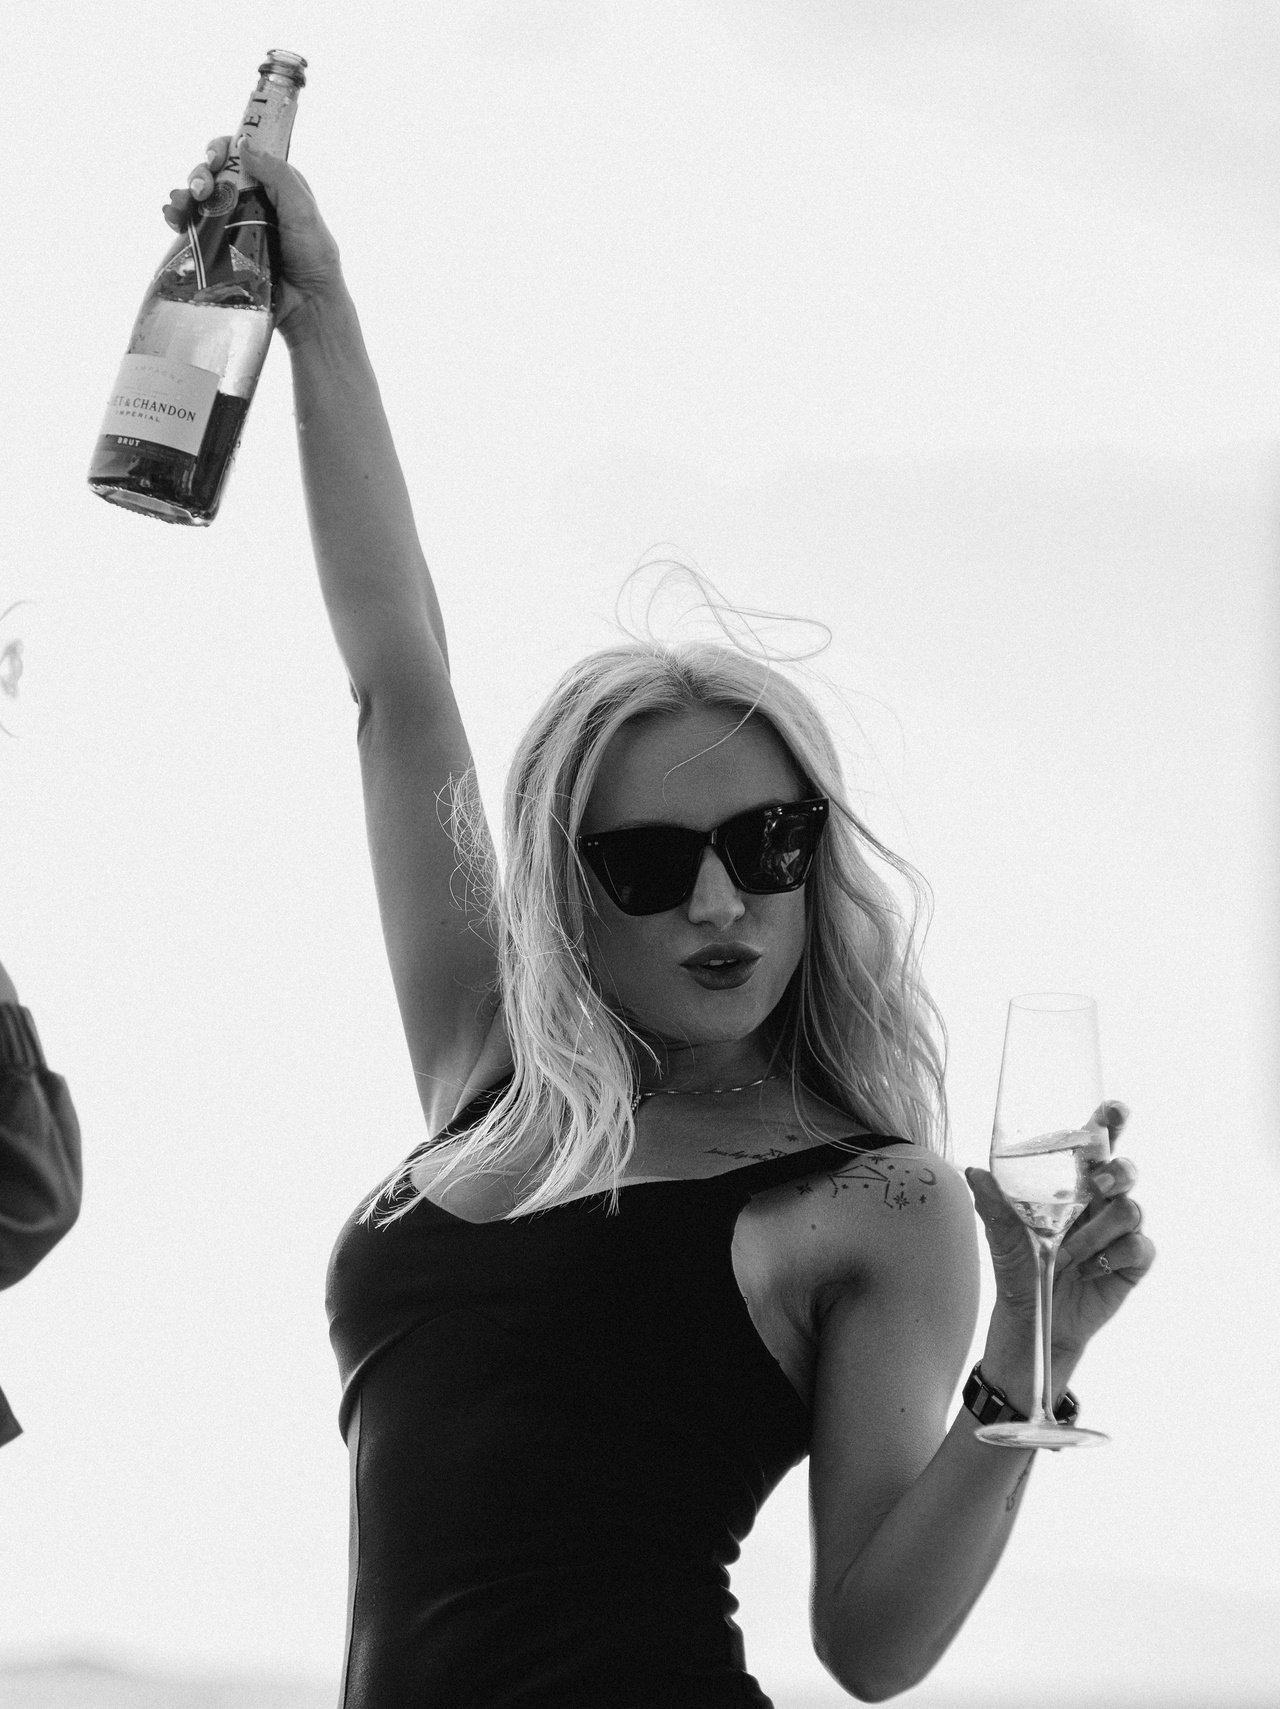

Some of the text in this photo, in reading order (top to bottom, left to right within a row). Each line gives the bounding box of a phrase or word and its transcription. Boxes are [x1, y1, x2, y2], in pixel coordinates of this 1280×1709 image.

[124, 398, 131, 407] &
[133, 397, 197, 422] CHANDON
[117, 436, 141, 447] BRUT
